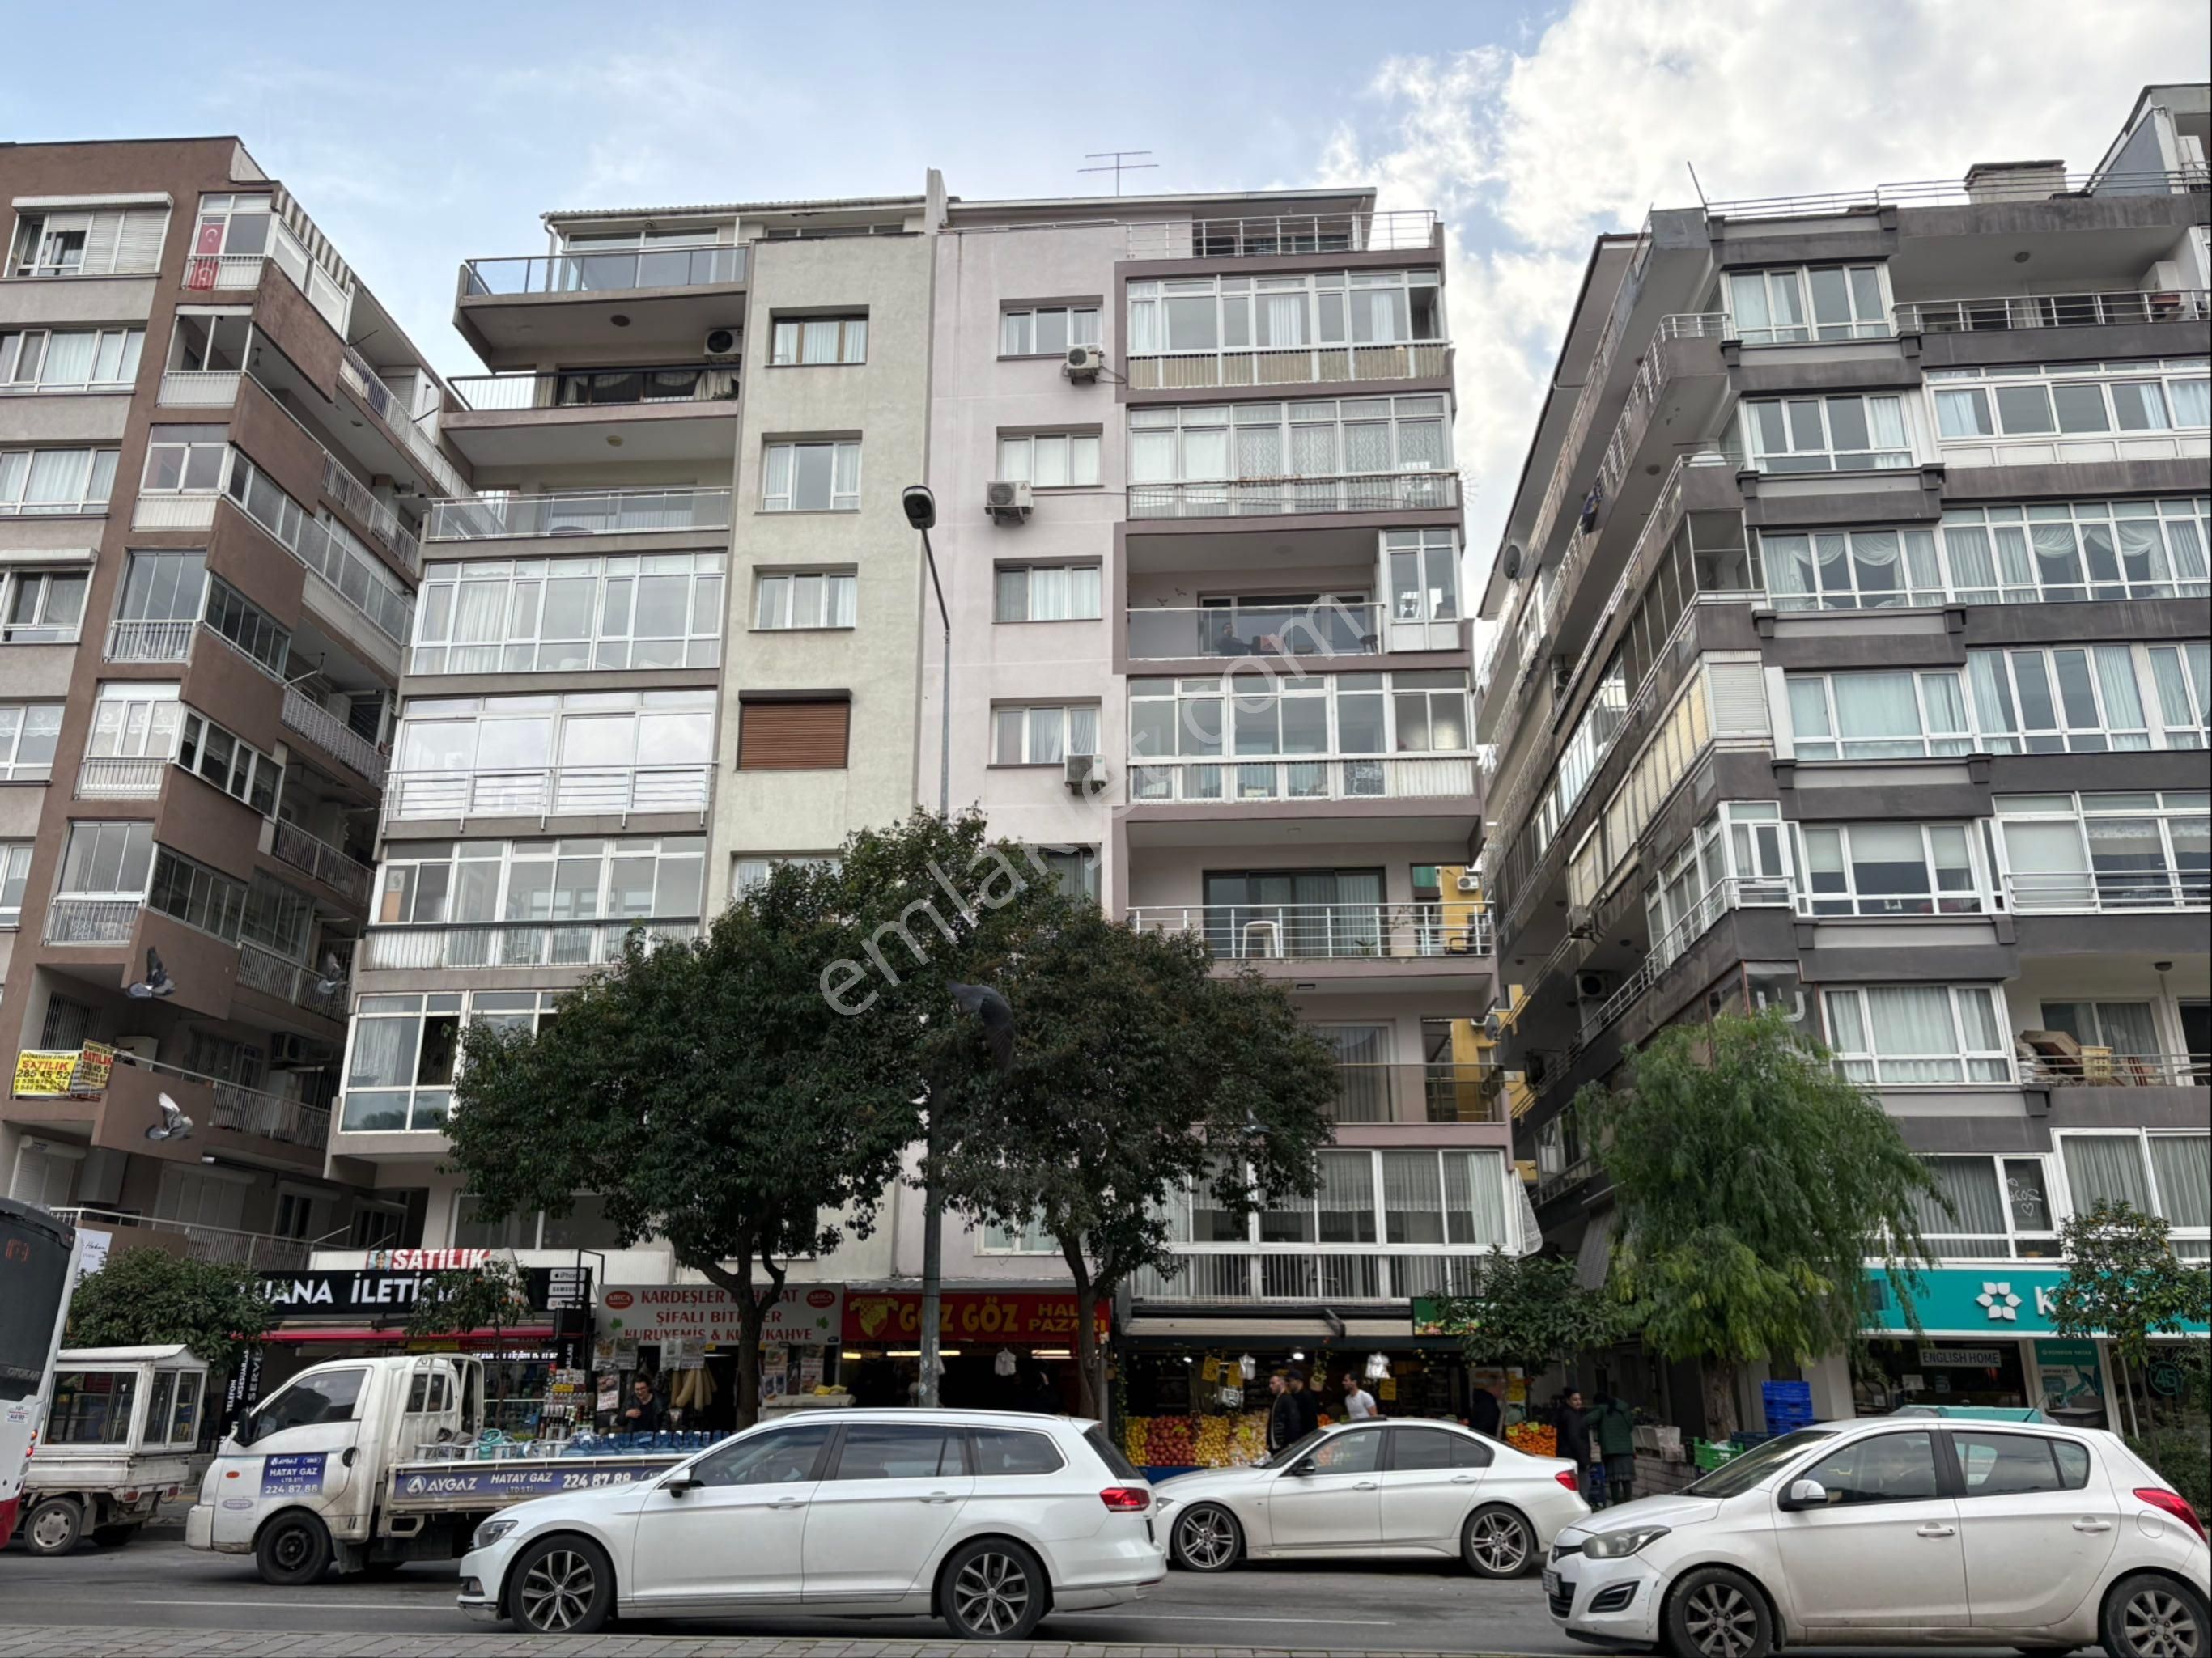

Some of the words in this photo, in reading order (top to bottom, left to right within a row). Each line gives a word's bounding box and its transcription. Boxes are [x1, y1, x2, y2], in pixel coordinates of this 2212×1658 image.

[83, 1050, 113, 1066] SATILIK
[23, 1060, 69, 1071] SATILIK
[16, 1069, 37, 1078] 285
[55, 1071, 70, 1079] 52
[393, 1249, 486, 1270] SATILIK
[559, 1271, 580, 1279] iPhon
[641, 1290, 725, 1308] KARDEŞLER
[899, 1303, 954, 1332] GZ
[962, 1296, 1019, 1332] GÖZ
[1038, 1303, 1098, 1317] HAL
[656, 1308, 704, 1327] ŞİFALI
[711, 1329, 721, 1341] &
[1922, 1351, 1968, 1363] ENGLISH
[1969, 1353, 1999, 1364] HOME
[225, 1379, 237, 1413] TELEFON
[270, 1468, 297, 1477] HATAY
[299, 1467, 318, 1476] GAZ
[427, 1475, 479, 1492] AYGAZ
[490, 1473, 528, 1484] HATAY
[529, 1472, 554, 1483] GAZ
[562, 1473, 588, 1489] 224
[591, 1473, 611, 1487] 87
[613, 1472, 631, 1486] 88
[265, 1485, 285, 1495] 224
[287, 1484, 301, 1493] 87
[304, 1484, 318, 1493] 88
